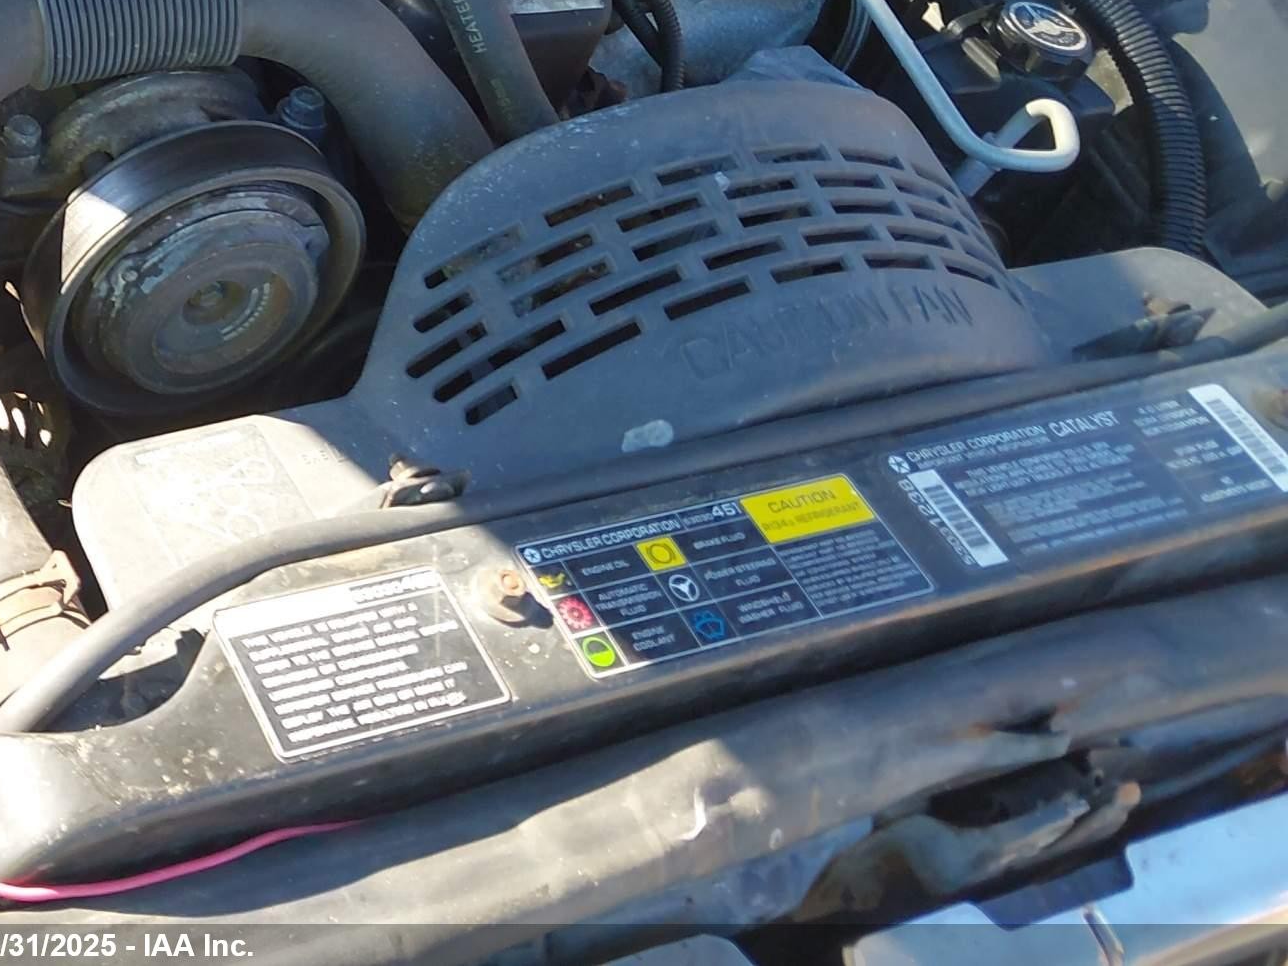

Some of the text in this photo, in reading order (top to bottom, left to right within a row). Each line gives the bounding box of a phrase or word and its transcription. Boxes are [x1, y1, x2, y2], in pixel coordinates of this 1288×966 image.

[905, 440, 968, 463] CHRYSLER
[965, 424, 1049, 451] CORPORATION
[1048, 410, 1121, 438] CATALYST
[767, 489, 838, 514] CAUTION
[541, 535, 604, 559] CHRYSLER
[599, 519, 682, 545] CORPORATION
[735, 574, 762, 587] FLUID
[597, 583, 649, 601] AUTOMATIC
[619, 605, 648, 617] FLUID
[632, 634, 676, 652] COOLANT
